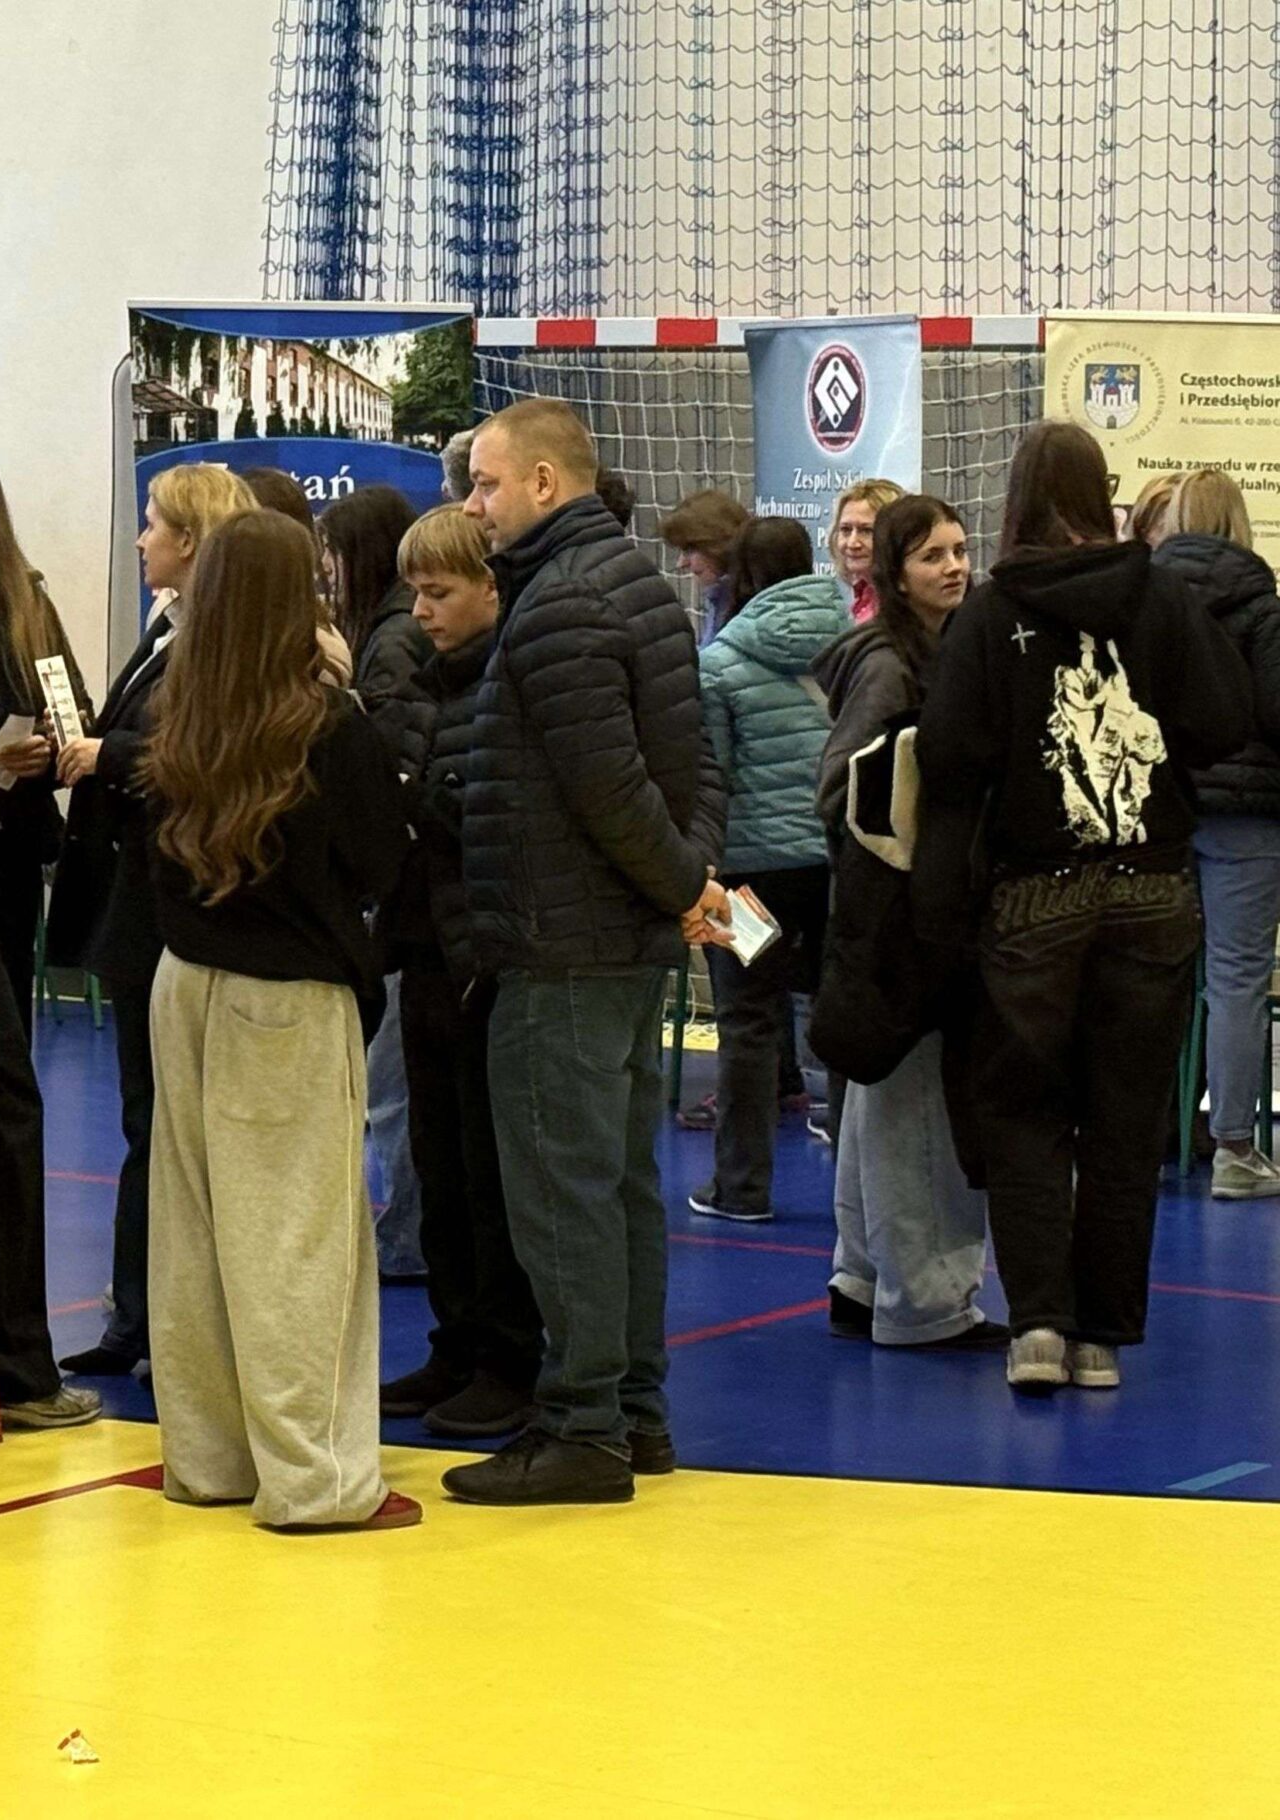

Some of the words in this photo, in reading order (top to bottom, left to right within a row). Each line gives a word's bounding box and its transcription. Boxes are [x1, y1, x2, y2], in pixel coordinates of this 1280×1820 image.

[1137, 457, 1183, 470] Nauka
[1186, 458, 1241, 471] zawodu
[1245, 462, 1257, 471] w
[793, 467, 831, 494] Zespół
